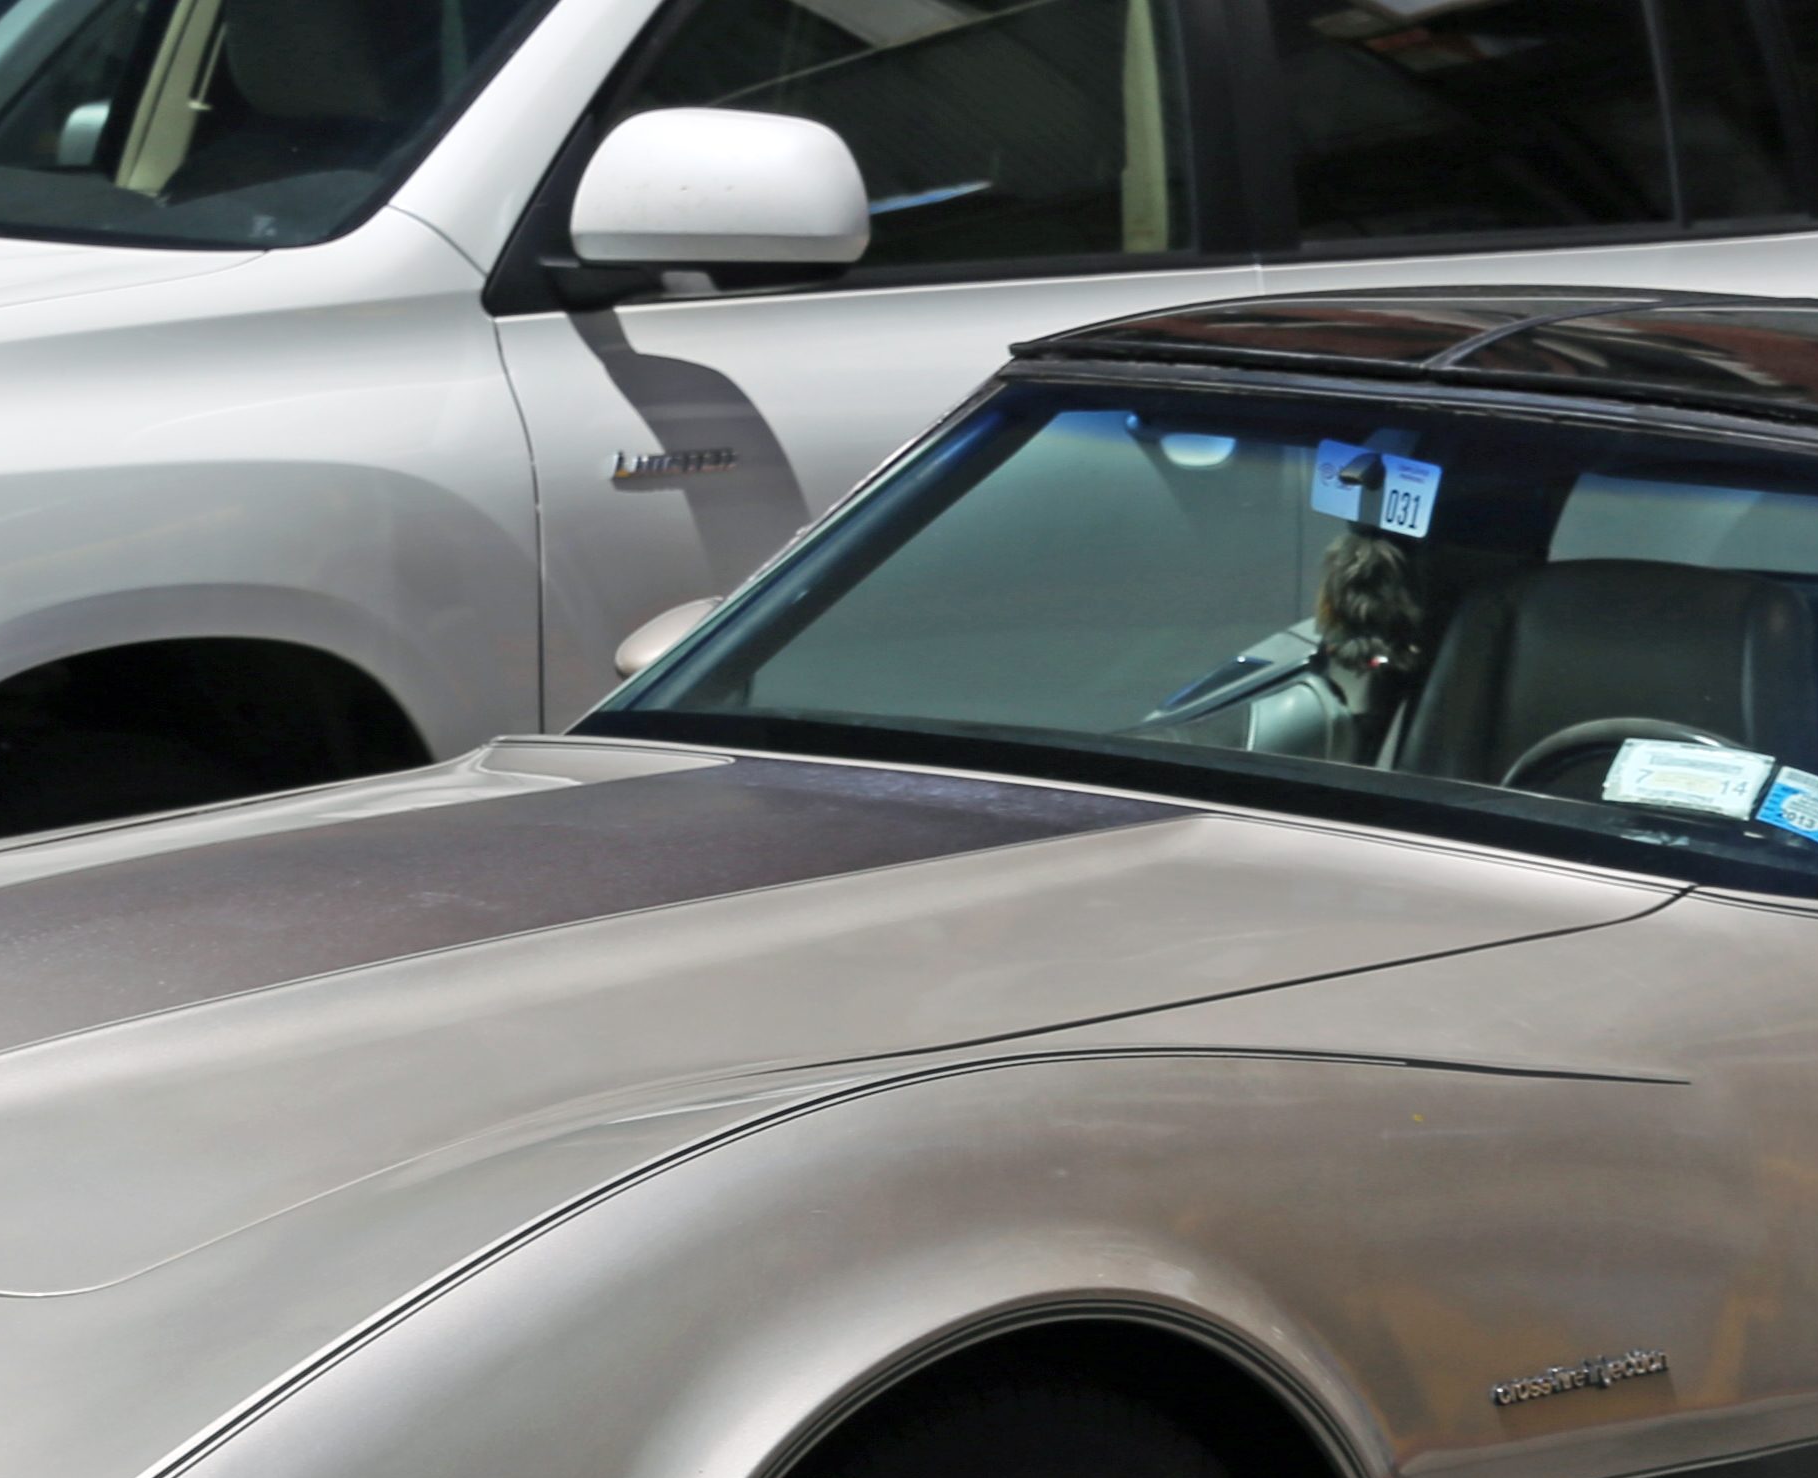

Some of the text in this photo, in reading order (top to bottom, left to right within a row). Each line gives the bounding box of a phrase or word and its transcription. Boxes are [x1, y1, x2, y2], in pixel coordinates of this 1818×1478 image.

[1385, 489, 1421, 529] 031
[1635, 768, 1654, 785] 7
[1720, 780, 1750, 797] 14
